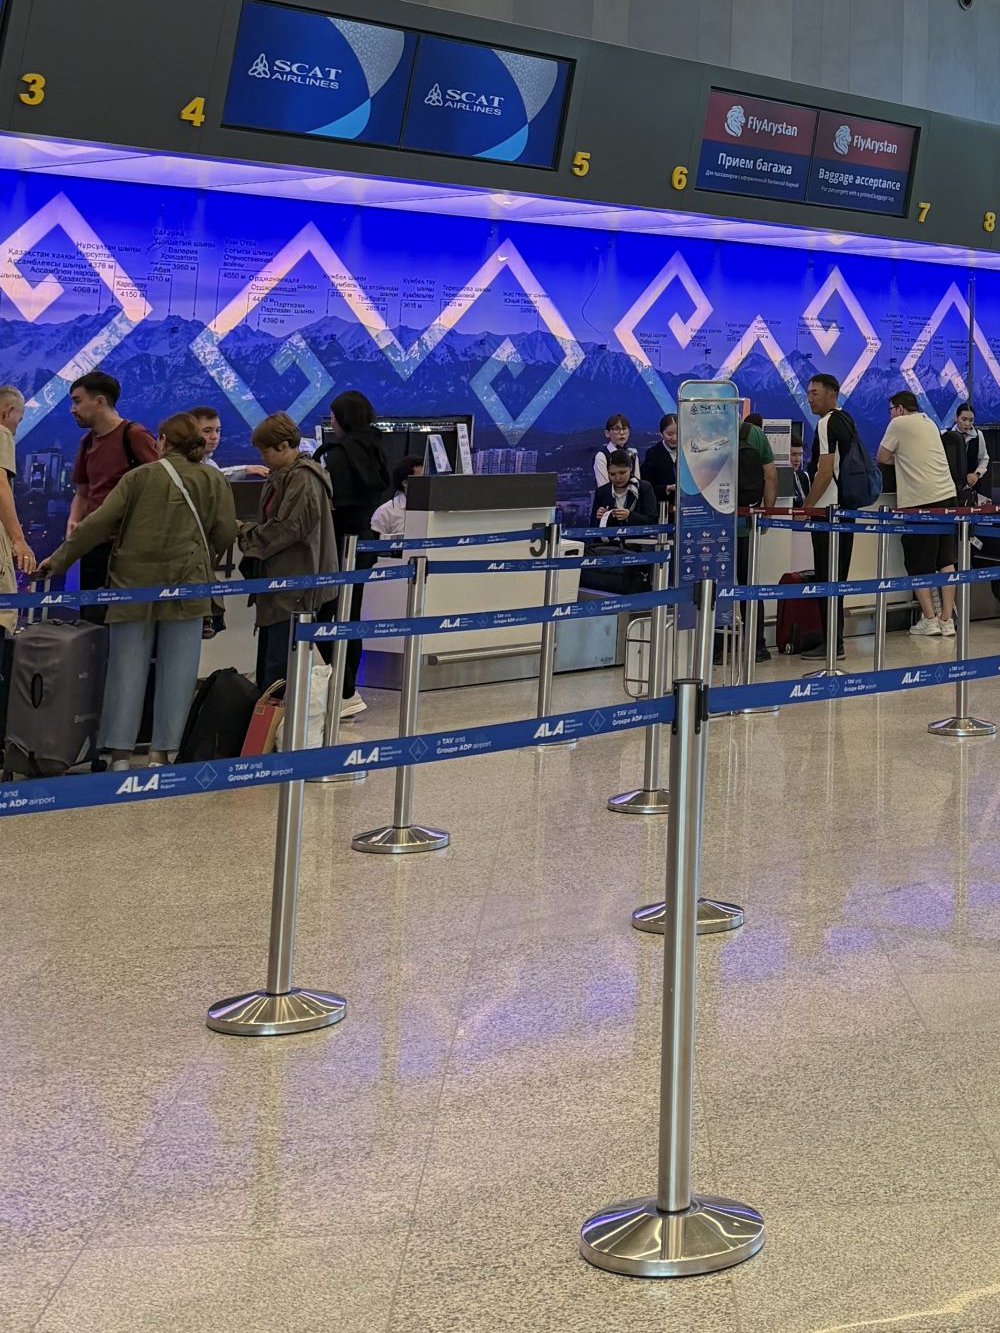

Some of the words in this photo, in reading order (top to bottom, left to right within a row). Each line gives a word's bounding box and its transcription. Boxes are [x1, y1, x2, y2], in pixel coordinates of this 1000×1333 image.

[273, 59, 342, 80] SCAT
[272, 72, 339, 90] AIRLINES
[18, 74, 46, 106] 3
[446, 88, 504, 108] SCAT
[180, 97, 206, 127] 4
[444, 100, 502, 116] AIRLINES
[748, 116, 798, 137] FlyArystan
[853, 135, 898, 154] FlyArystan
[572, 152, 590, 177] 5
[718, 152, 754, 170] Прием
[756, 158, 793, 176] багажа
[671, 166, 688, 191] 6
[818, 168, 854, 186] Baggage
[855, 175, 900, 191] acceptance
[918, 202, 931, 223] 7
[983, 212, 996, 232] 8
[390, 541, 403, 549] ALA
[457, 537, 470, 545] ALA
[581, 558, 597, 566] ALA
[368, 570, 386, 580] ALA
[268, 579, 287, 589] ALA
[802, 586, 817, 594] ALA
[878, 581, 891, 589] ALA
[40, 594, 62, 604] ALA
[159, 588, 180, 598] ALA
[719, 588, 734, 597] ALA
[552, 606, 570, 617] ALA
[440, 618, 460, 629] ALA
[314, 625, 338, 637] ALA
[902, 670, 920, 684] ALA
[790, 683, 812, 698] ALA
[612, 717, 631, 726] Groupe
[643, 712, 659, 720] airport
[533, 720, 564, 739] ALA
[436, 746, 458, 755] Groupe
[459, 743, 472, 751] ADP
[472, 740, 492, 750] airport
[442, 737, 455, 745] TAV
[343, 747, 379, 766] ALA
[235, 763, 249, 771] TAV
[227, 774, 254, 782] Groupe
[255, 770, 270, 778] ADP
[271, 768, 294, 777] airport
[115, 774, 160, 794] ALA
[9, 796, 28, 808] ADP
[28, 796, 55, 805] airport
